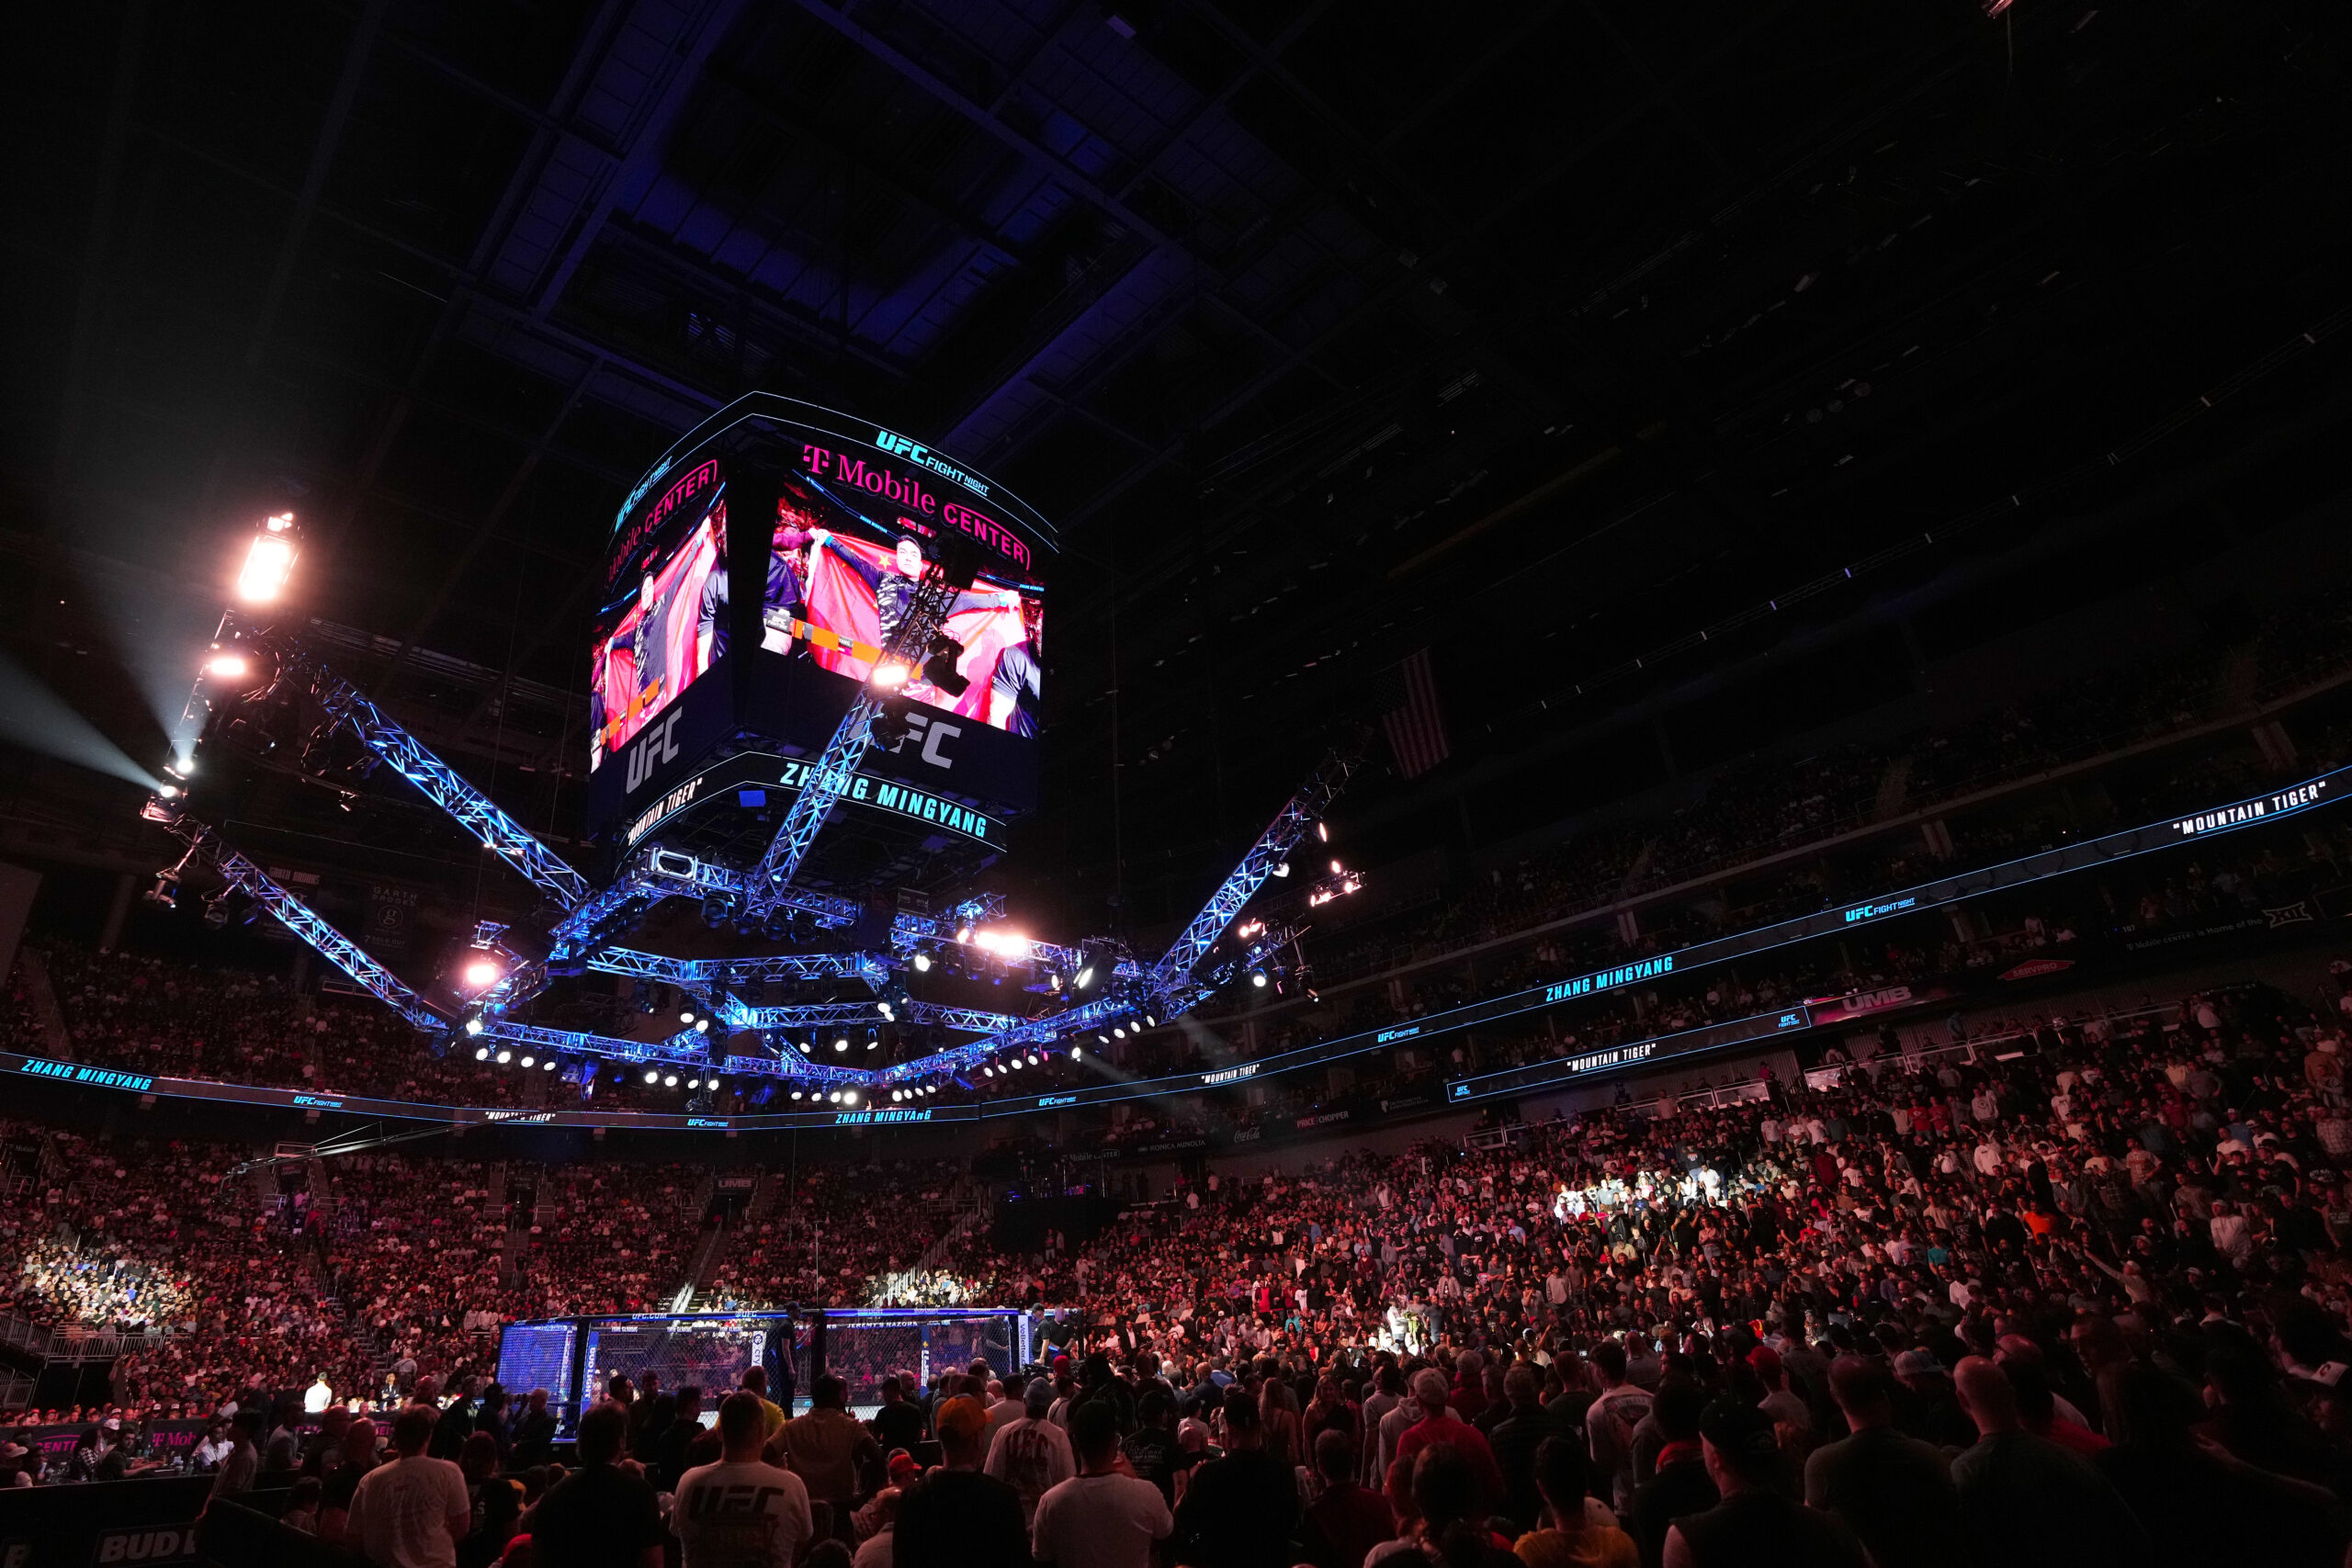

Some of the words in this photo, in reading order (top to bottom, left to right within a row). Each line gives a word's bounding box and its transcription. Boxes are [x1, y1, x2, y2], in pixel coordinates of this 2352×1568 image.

[876, 430, 928, 465] UFC
[925, 457, 965, 482] FIGHT
[964, 475, 989, 496] NIGHT
[645, 468, 710, 533] CENTER
[803, 445, 830, 474] T
[837, 454, 935, 513] Mobile
[944, 504, 1024, 564] CENTER
[626, 705, 683, 795] UFC
[666, 777, 703, 814] TIGER"
[2173, 801, 2265, 834] "MOUNTAIN
[2272, 781, 2325, 810] TIGER"
[876, 784, 987, 838] MINGYANG
[1846, 905, 1873, 922] UFC
[1873, 902, 1898, 916] FIGHT
[1897, 897, 1915, 908] NIGHT
[2206, 925, 2234, 935] Home
[2247, 919, 2263, 928] the
[1545, 978, 1590, 1002] ZHANG
[1596, 956, 1673, 989] MINGYANG
[2012, 962, 2057, 978] SERVPRO
[1842, 986, 1912, 1011] UMB
[1781, 1013, 1795, 1023] UFC
[1378, 1030, 1395, 1043] UFC
[1394, 1029, 1409, 1039] FIGHT
[1566, 1048, 1618, 1073] "MOUNTAIN
[1623, 1043, 1657, 1063] TIGER"
[21, 1059, 74, 1078] ZHANG
[76, 1068, 153, 1090] MINGYANG
[1201, 1069, 1238, 1084] "MOUNTAIN
[1239, 1063, 1260, 1077] TIGER"
[294, 1096, 316, 1105] UFC
[1039, 1097, 1055, 1107] UFC
[835, 1112, 872, 1124] ZHANG
[875, 1110, 932, 1122] MINGYANG
[1296, 1117, 1316, 1129] PRICE
[1318, 1111, 1350, 1124] CHOPPER
[1149, 1143, 1176, 1153] KONICA
[1176, 1139, 1205, 1149] MINOLTA
[718, 1179, 752, 1189] UMB
[587, 1348, 596, 1369] BUD
[584, 1370, 594, 1398] LIGHT
[1005, 1429, 1049, 1459] UFC
[690, 1486, 785, 1521] UFC
[99, 1530, 180, 1563] BUD
